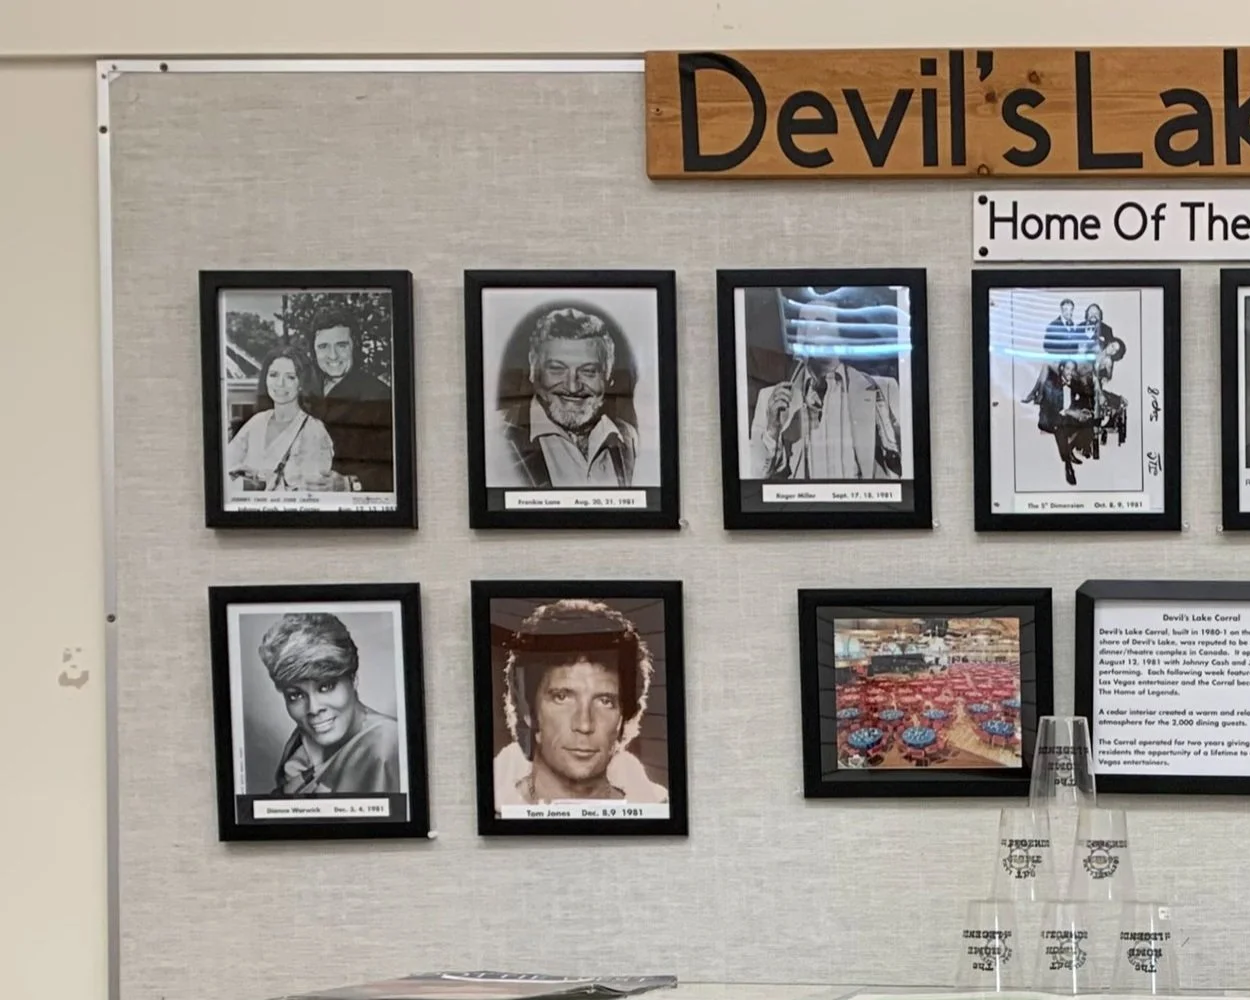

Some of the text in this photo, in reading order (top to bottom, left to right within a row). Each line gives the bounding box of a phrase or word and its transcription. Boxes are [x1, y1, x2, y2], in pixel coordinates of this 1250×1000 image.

[680, 50, 1052, 172] Devil's
[987, 202, 1100, 242] Home
[1114, 202, 1166, 242] Of
[1162, 613, 1241, 622] Devil's Lake Corral
[1098, 657, 1126, 669] August
[1142, 657, 1161, 666] 1981
[1163, 657, 1180, 666] with
[1182, 657, 1210, 669] Johnny
[1210, 657, 1230, 666] Cash
[1231, 657, 1247, 666] and
[526, 809, 545, 817] Tom
[547, 809, 571, 817] Jones
[581, 809, 600, 817] Dec.
